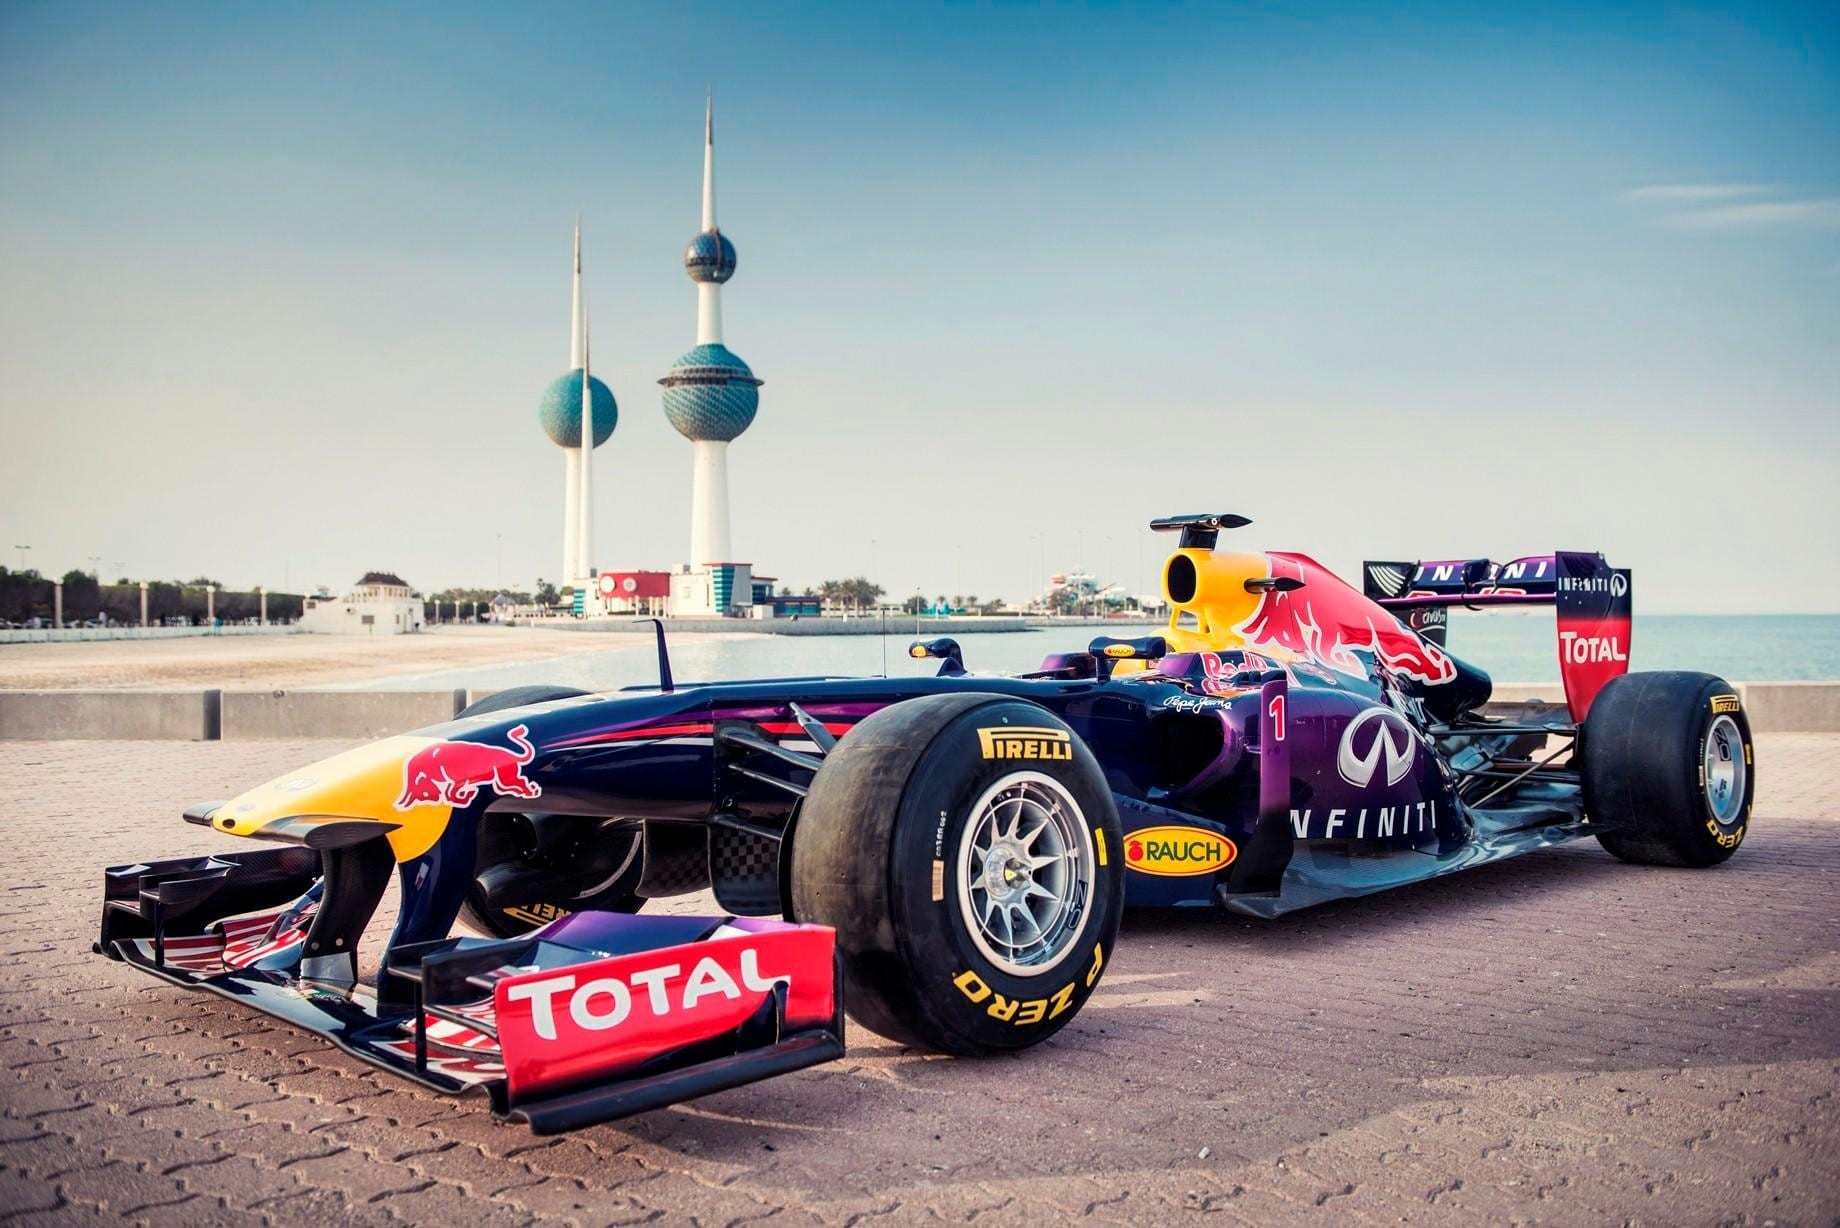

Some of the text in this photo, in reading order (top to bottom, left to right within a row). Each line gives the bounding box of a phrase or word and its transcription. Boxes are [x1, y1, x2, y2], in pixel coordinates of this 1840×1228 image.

[1558, 577, 1608, 592] INFINITI
[1560, 631, 1627, 664] TOTAL
[1163, 695, 1194, 713] Pepe
[1269, 695, 1286, 741] 1
[1710, 694, 1740, 714] PIRELLI
[977, 726, 1073, 760] PIRELLI
[1289, 800, 1436, 839] NFINITI
[1706, 819, 1744, 849] ZERO
[1146, 841, 1221, 862] RAUCH
[508, 948, 791, 1041] TOTAL
[953, 942, 1103, 1026] P ZERO
